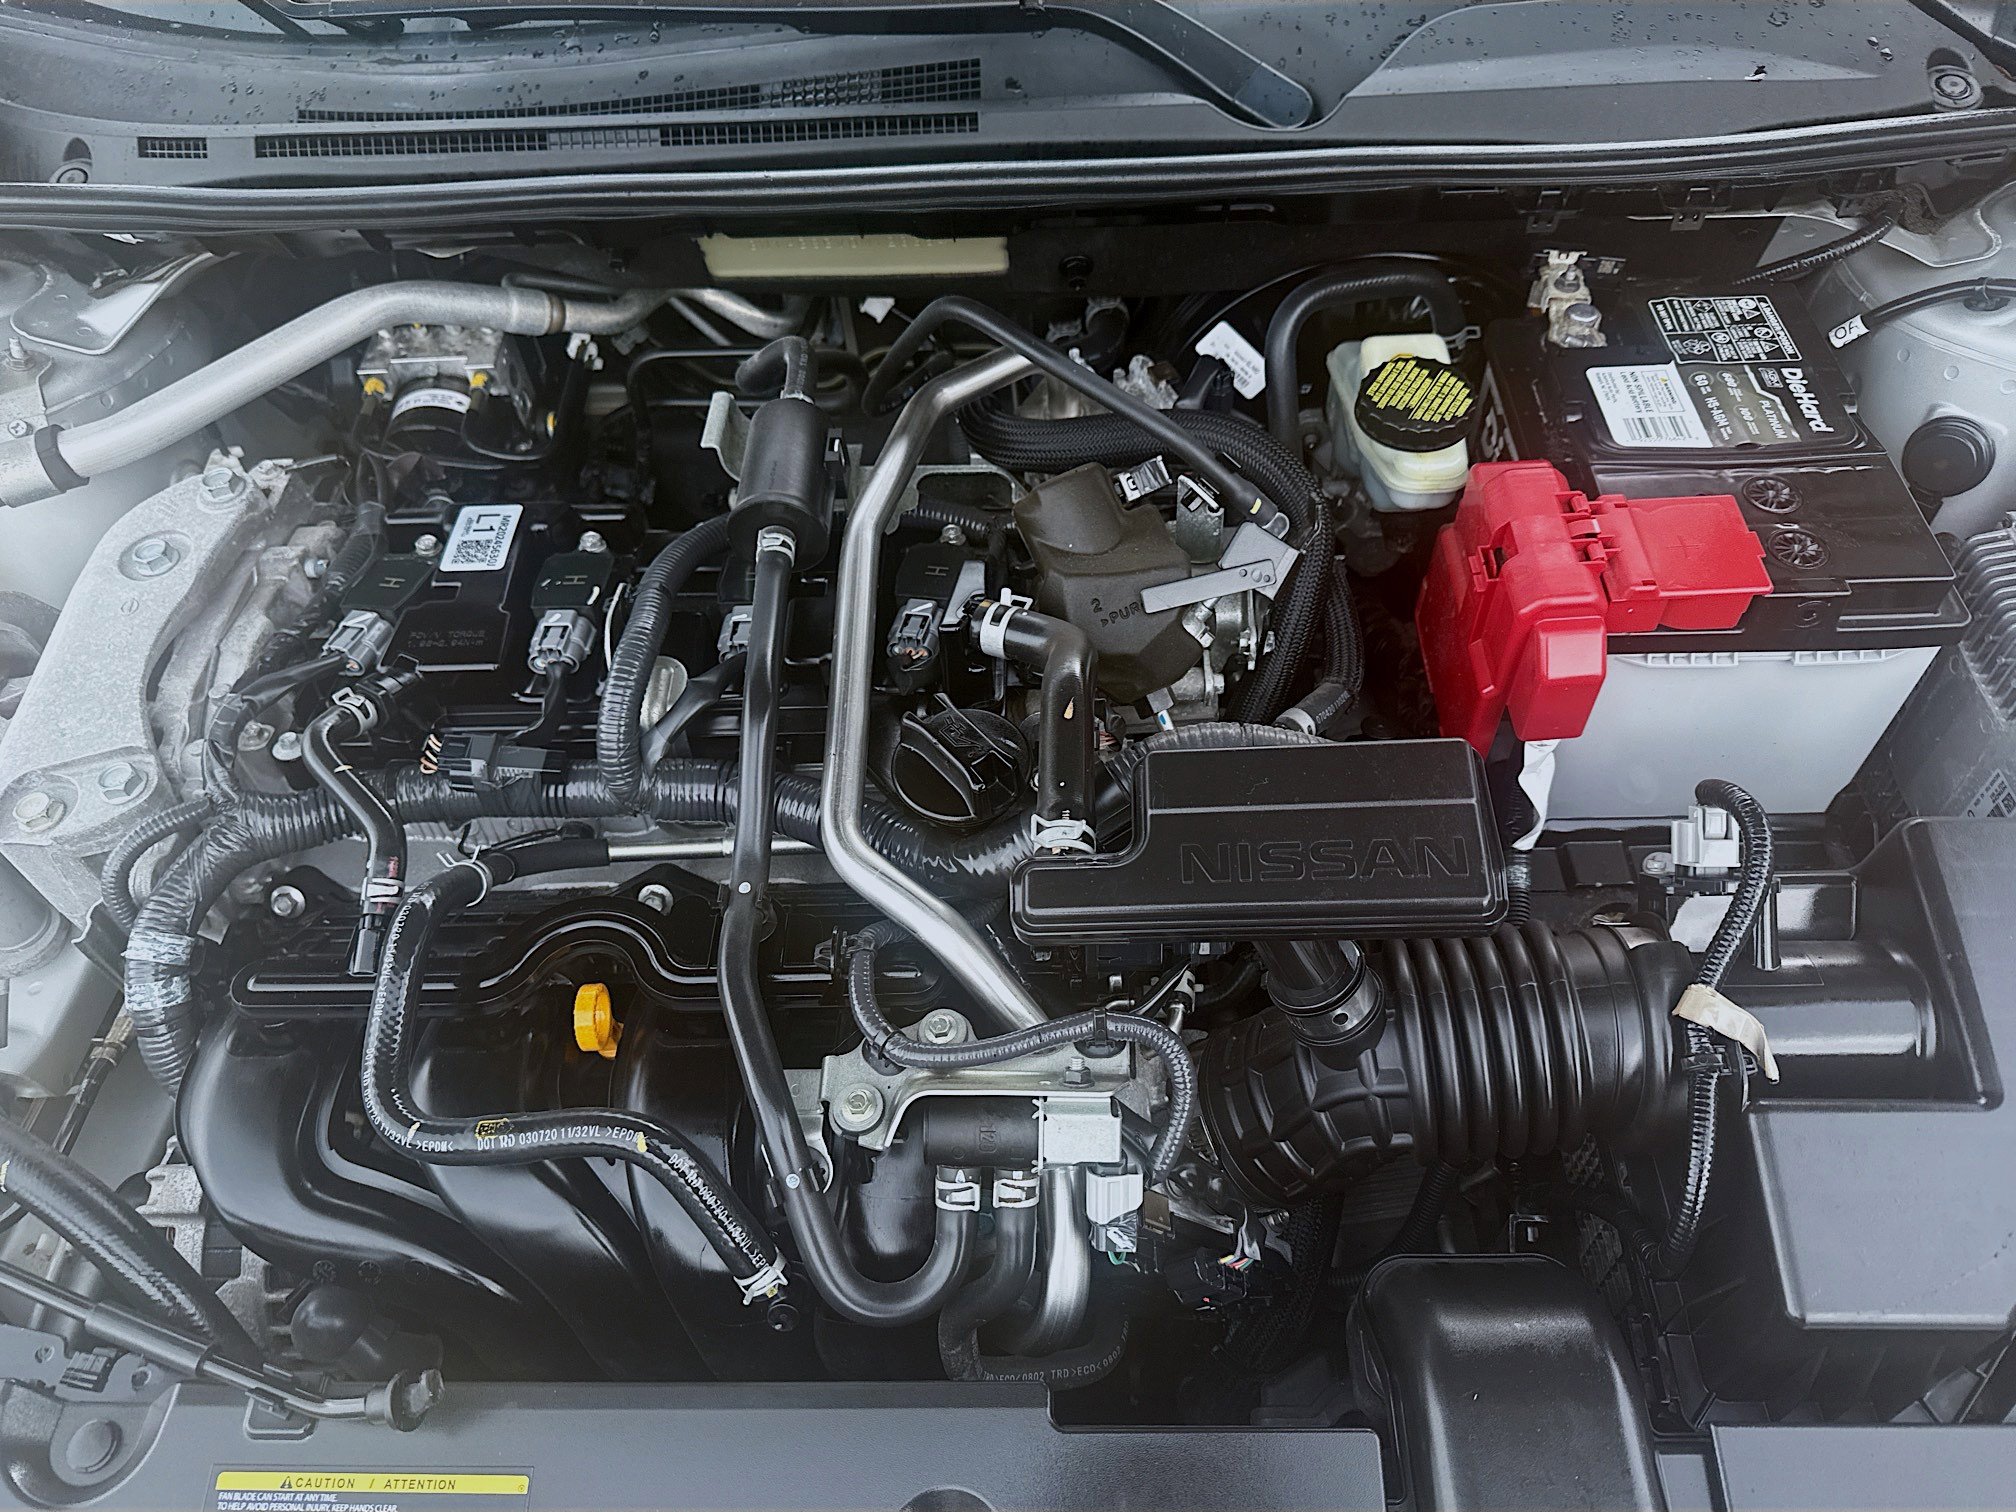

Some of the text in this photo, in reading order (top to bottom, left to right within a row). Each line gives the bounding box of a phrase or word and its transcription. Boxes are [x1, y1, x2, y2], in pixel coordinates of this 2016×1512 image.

[1694, 374, 1709, 387] 60
[1780, 368, 1834, 433] DieHard
[1759, 400, 1788, 438] PLATINUM
[473, 513, 500, 532] L1
[1180, 836, 1469, 884] NISSAN
[477, 1137, 496, 1151] DOT
[519, 1129, 558, 1144] 030720
[605, 1126, 641, 1143] >EPDM
[295, 1478, 356, 1489] CAUTION
[384, 1479, 456, 1490] ATTENTION
[218, 1492, 233, 1501] FAN
[234, 1492, 256, 1501] BLADE
[257, 1492, 273, 1501] CAN
[273, 1492, 295, 1501] START
[296, 1492, 304, 1501] AT
[305, 1492, 320, 1501] ANY
[218, 1502, 228, 1510] TO
[228, 1502, 246, 1511] HELP
[247, 1502, 269, 1511] AVOID
[270, 1502, 304, 1511] PERSONAL
[332, 1502, 350, 1512] KEEP
[350, 1502, 376, 1512] HANDS
